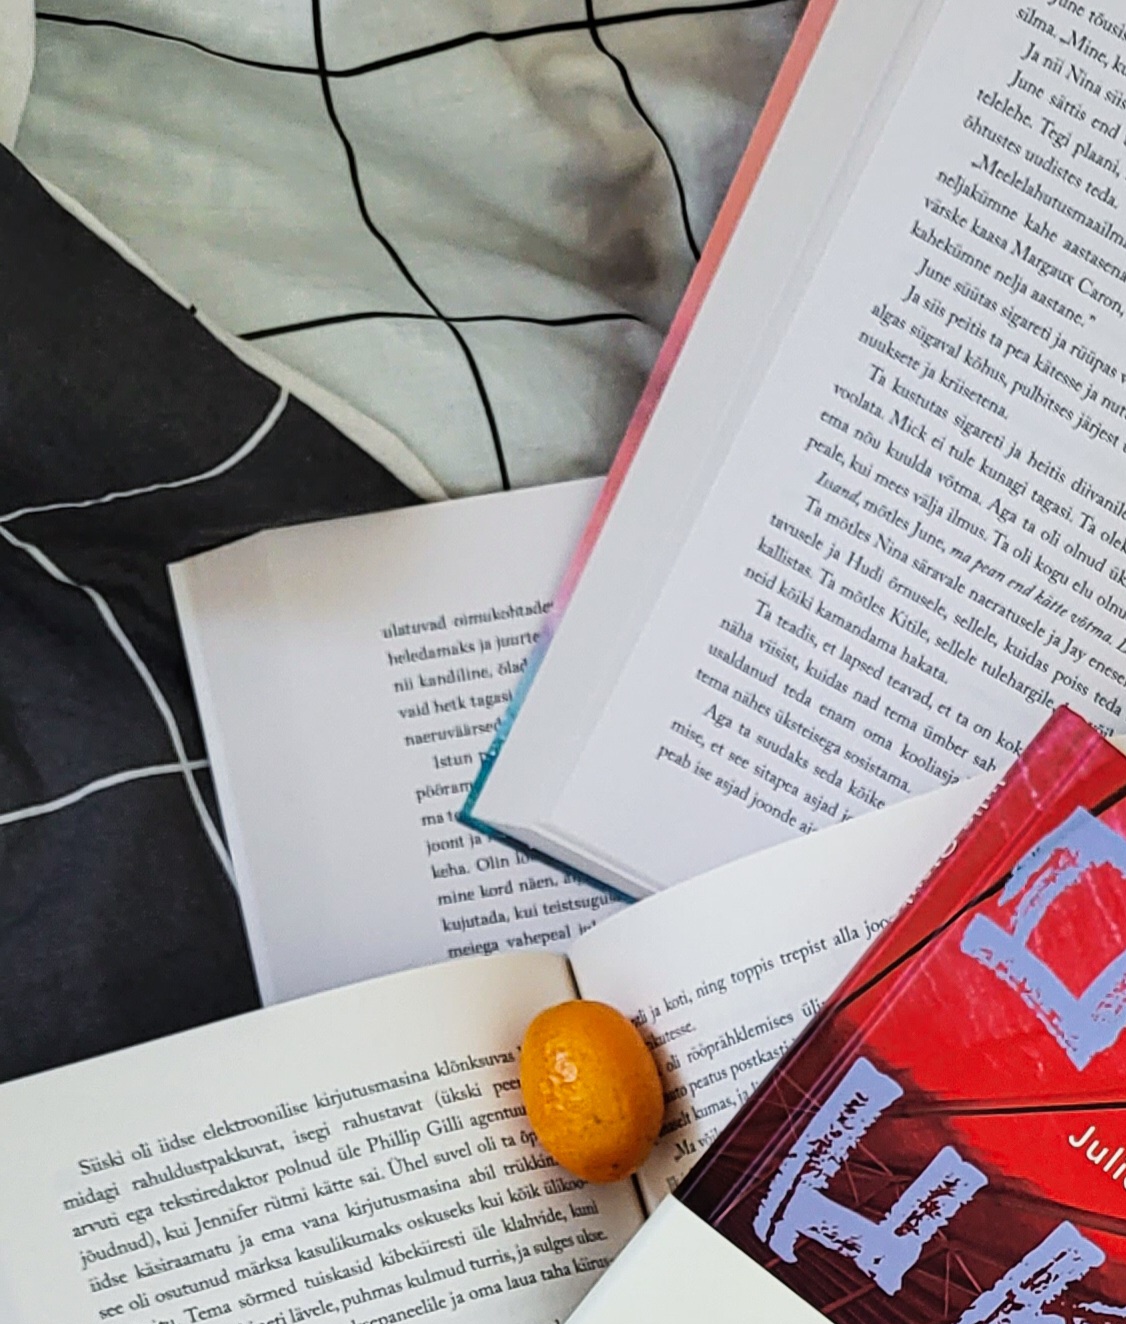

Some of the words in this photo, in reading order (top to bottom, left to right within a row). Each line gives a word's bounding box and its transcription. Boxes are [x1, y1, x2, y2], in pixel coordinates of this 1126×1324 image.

[1020, 41, 1040, 63] Ja
[1042, 57, 1064, 75] nii
[1065, 64, 1102, 96] Nina
[910, 220, 991, 275] kahekümne
[993, 270, 1028, 295] nelja
[914, 258, 951, 287] June
[953, 282, 998, 311] süütas
[1000, 306, 1053, 341] sigareti
[1048, 332, 1067, 350] ja
[1069, 345, 1117, 378] rüüpas
[744, 567, 778, 590] neid
[777, 580, 814, 611] kõiki
[815, 600, 897, 656] kamandama
[899, 646, 948, 684] hakata.
[398, 701, 430, 718] vaid
[432, 695, 467, 714] hetk
[431, 863, 470, 879] keha.
[475, 856, 510, 872] Olin
[438, 891, 475, 906] mine
[479, 880, 514, 898] kord
[518, 877, 558, 892] näen,
[442, 910, 510, 932] kujutada,
[513, 905, 538, 920] kui
[650, 1006, 661, 1025] ja
[663, 990, 693, 1012] koti,
[696, 978, 727, 998] ning
[730, 958, 774, 984] toppis
[779, 939, 827, 965] trepist
[833, 925, 860, 946] alla
[666, 1053, 682, 1073] oli
[687, 1013, 794, 1063] rööprähklemises
[78, 1151, 125, 1175] Siiski
[131, 1142, 153, 1160] oli
[158, 1133, 196, 1153] iidse
[203, 1103, 309, 1140] elektroonilise
[313, 1070, 430, 1109] kirjutusmasina
[434, 1052, 516, 1077] klõnksuvas
[288, 1298, 340, 1324] lävele,
[341, 1282, 404, 1312] puhmas
[404, 1258, 467, 1289] kulmud
[469, 1249, 516, 1271] turris,
[516, 1244, 533, 1265] ja
[533, 1236, 575, 1255] sulges
[576, 1228, 608, 1244] ukse.
